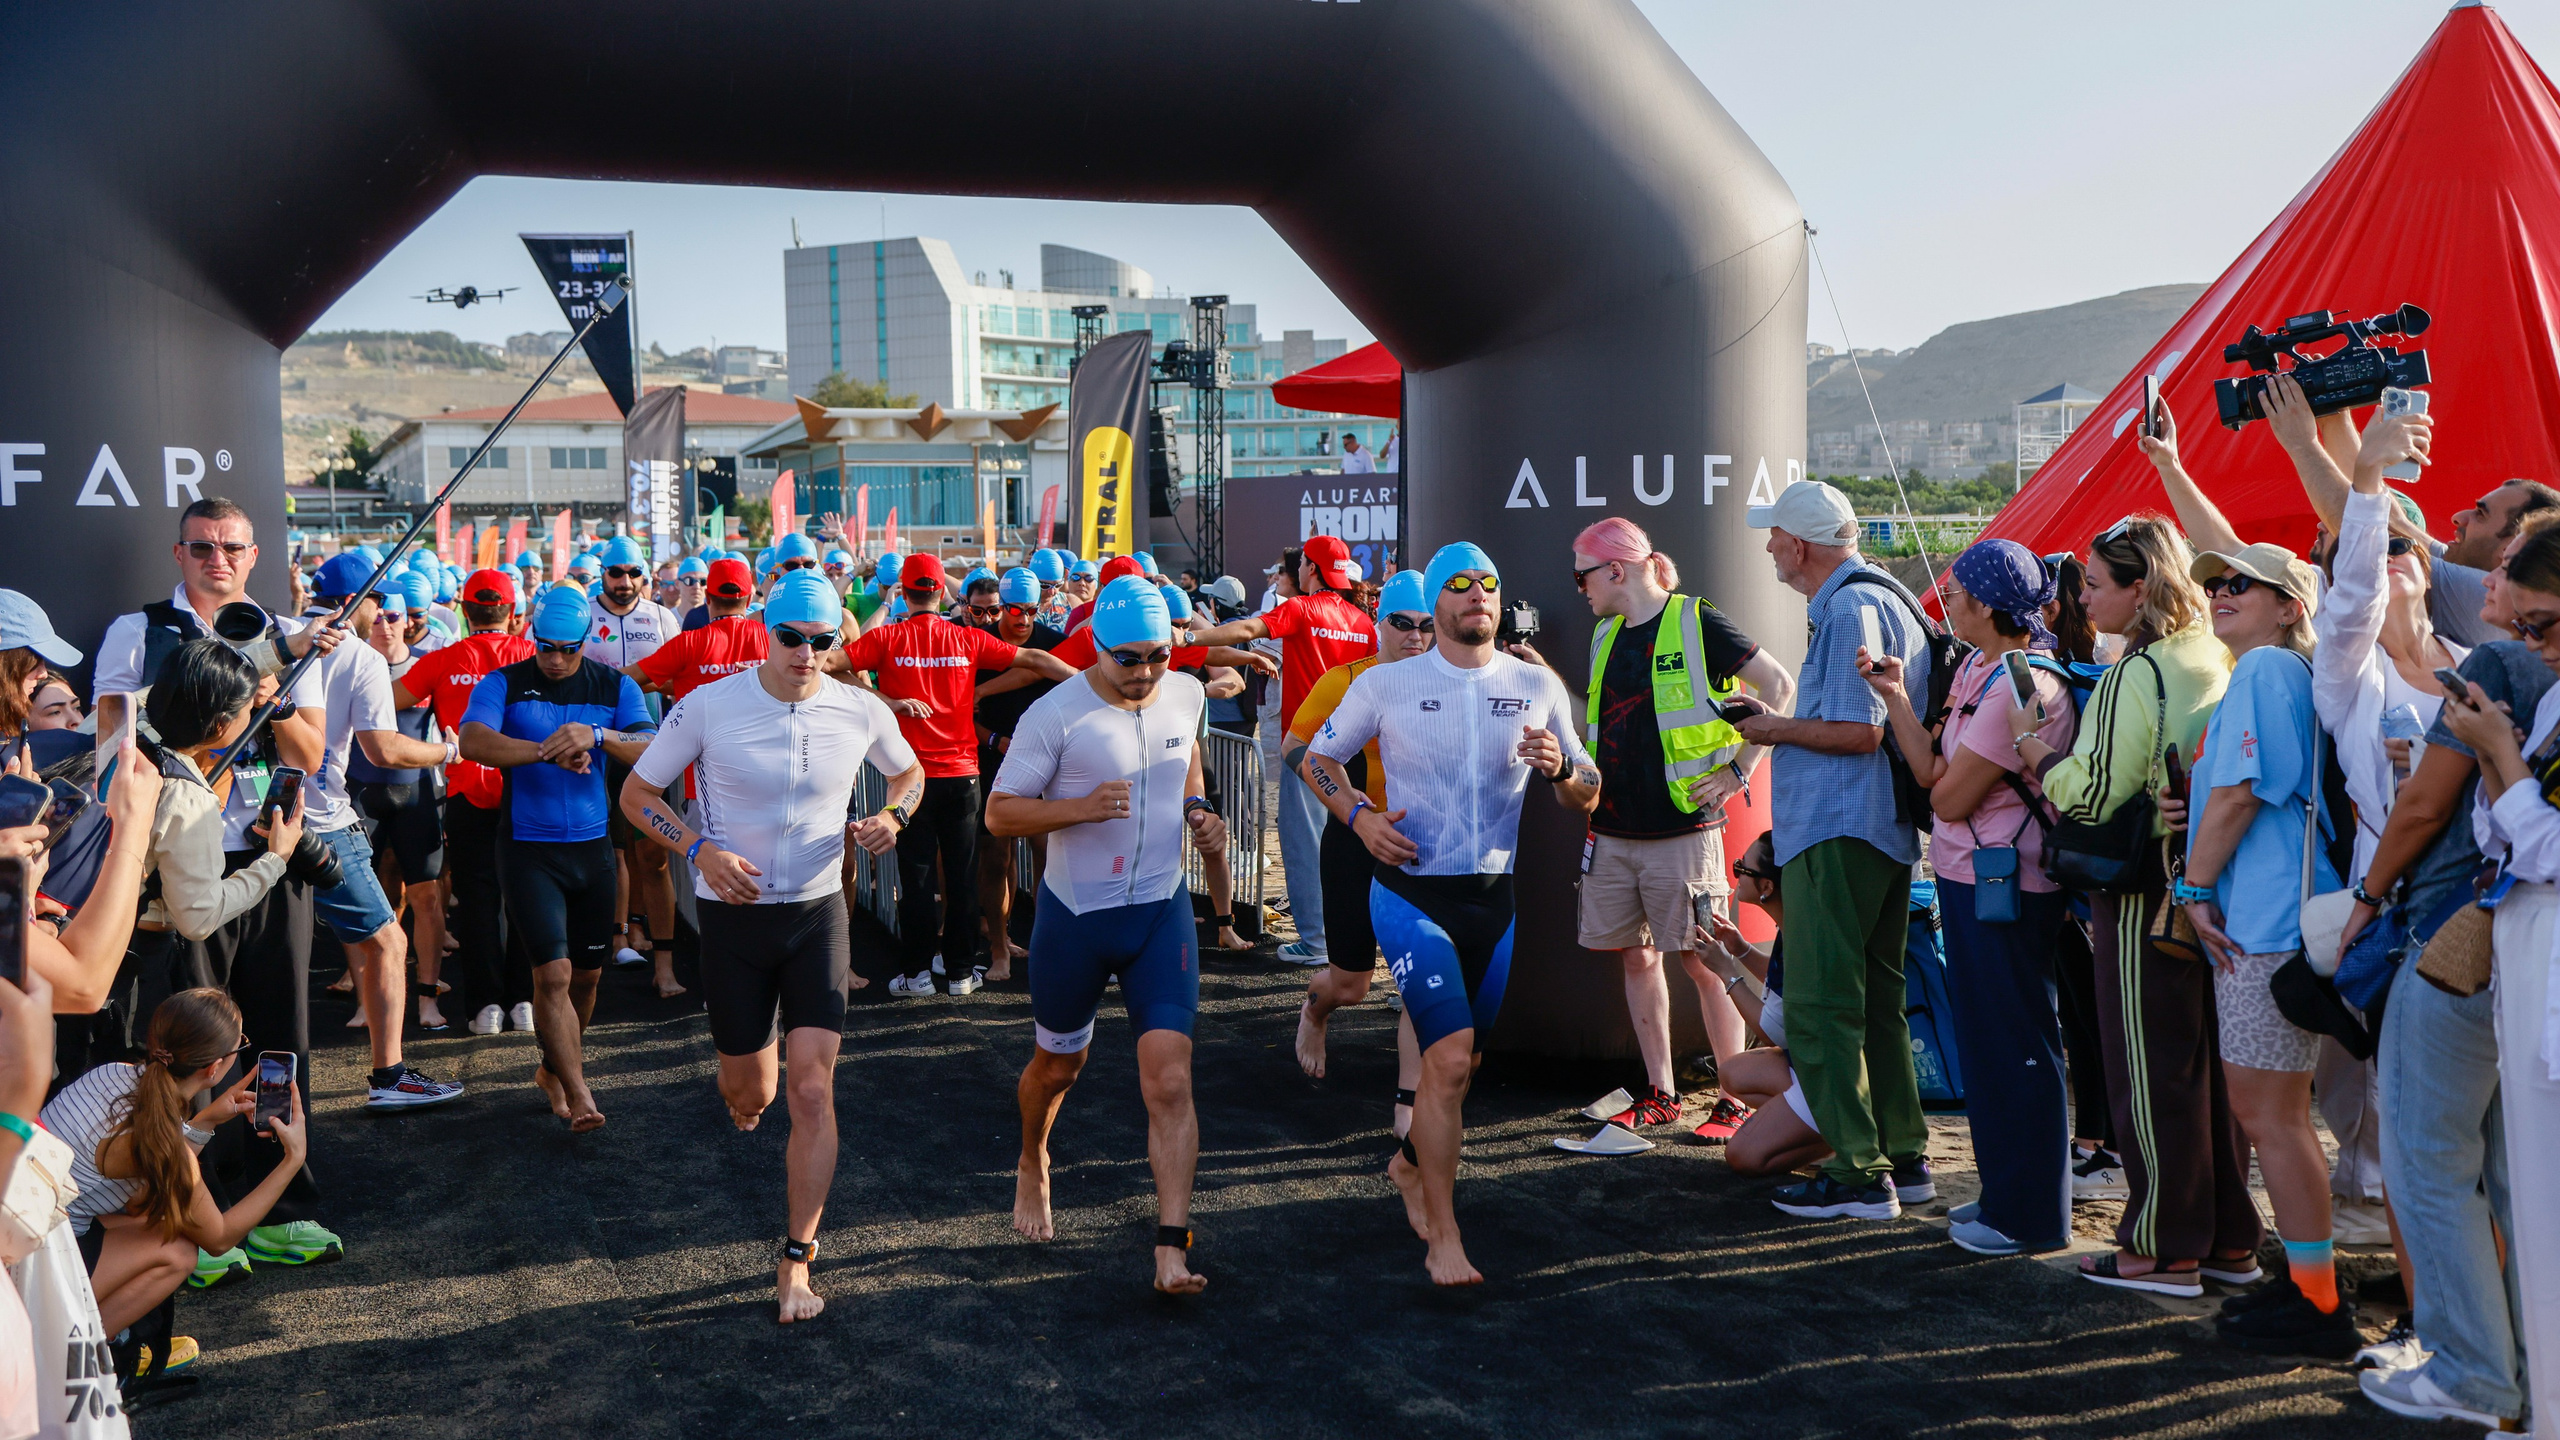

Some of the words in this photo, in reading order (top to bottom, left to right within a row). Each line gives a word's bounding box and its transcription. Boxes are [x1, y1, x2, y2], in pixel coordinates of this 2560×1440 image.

[629, 459, 651, 515] 70.3
[1301, 488, 1391, 505] ALUFAR
[1310, 626, 1369, 645] VOLUNTEER
[894, 656, 970, 669] VOLUNTEER
[801, 733, 809, 755] RYSEL
[236, 769, 268, 778] TEAM
[801, 757, 809, 773] VAN
